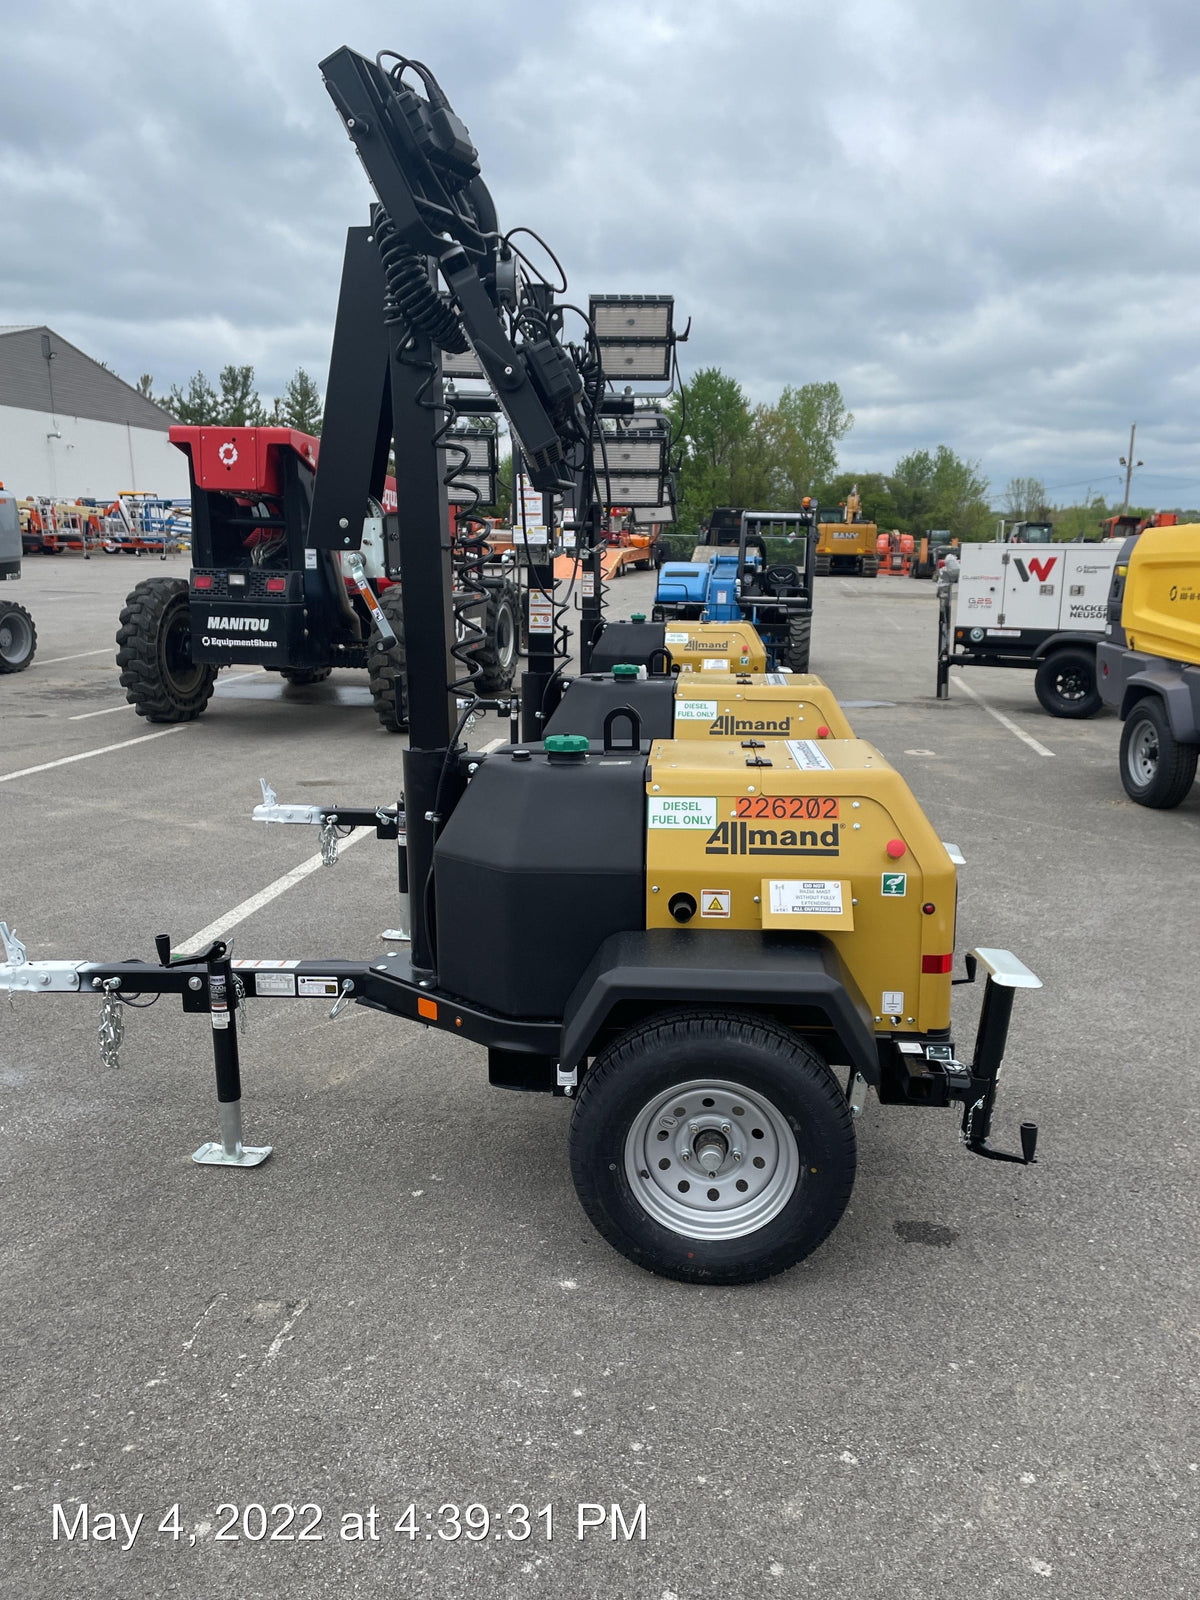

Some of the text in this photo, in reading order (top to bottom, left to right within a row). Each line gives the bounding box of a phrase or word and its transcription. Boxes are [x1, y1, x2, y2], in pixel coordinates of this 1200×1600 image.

[207, 616, 270, 632] MANITOU
[210, 637, 278, 648] EquipmentShare
[684, 640, 729, 652] Allmand
[684, 702, 709, 710] DIESEL
[677, 710, 715, 718] FUEL ONLY
[709, 715, 791, 736] Allmand
[662, 802, 702, 811] DIESEL
[652, 815, 713, 825] FUEL ONLY
[705, 821, 840, 856] Allmand
